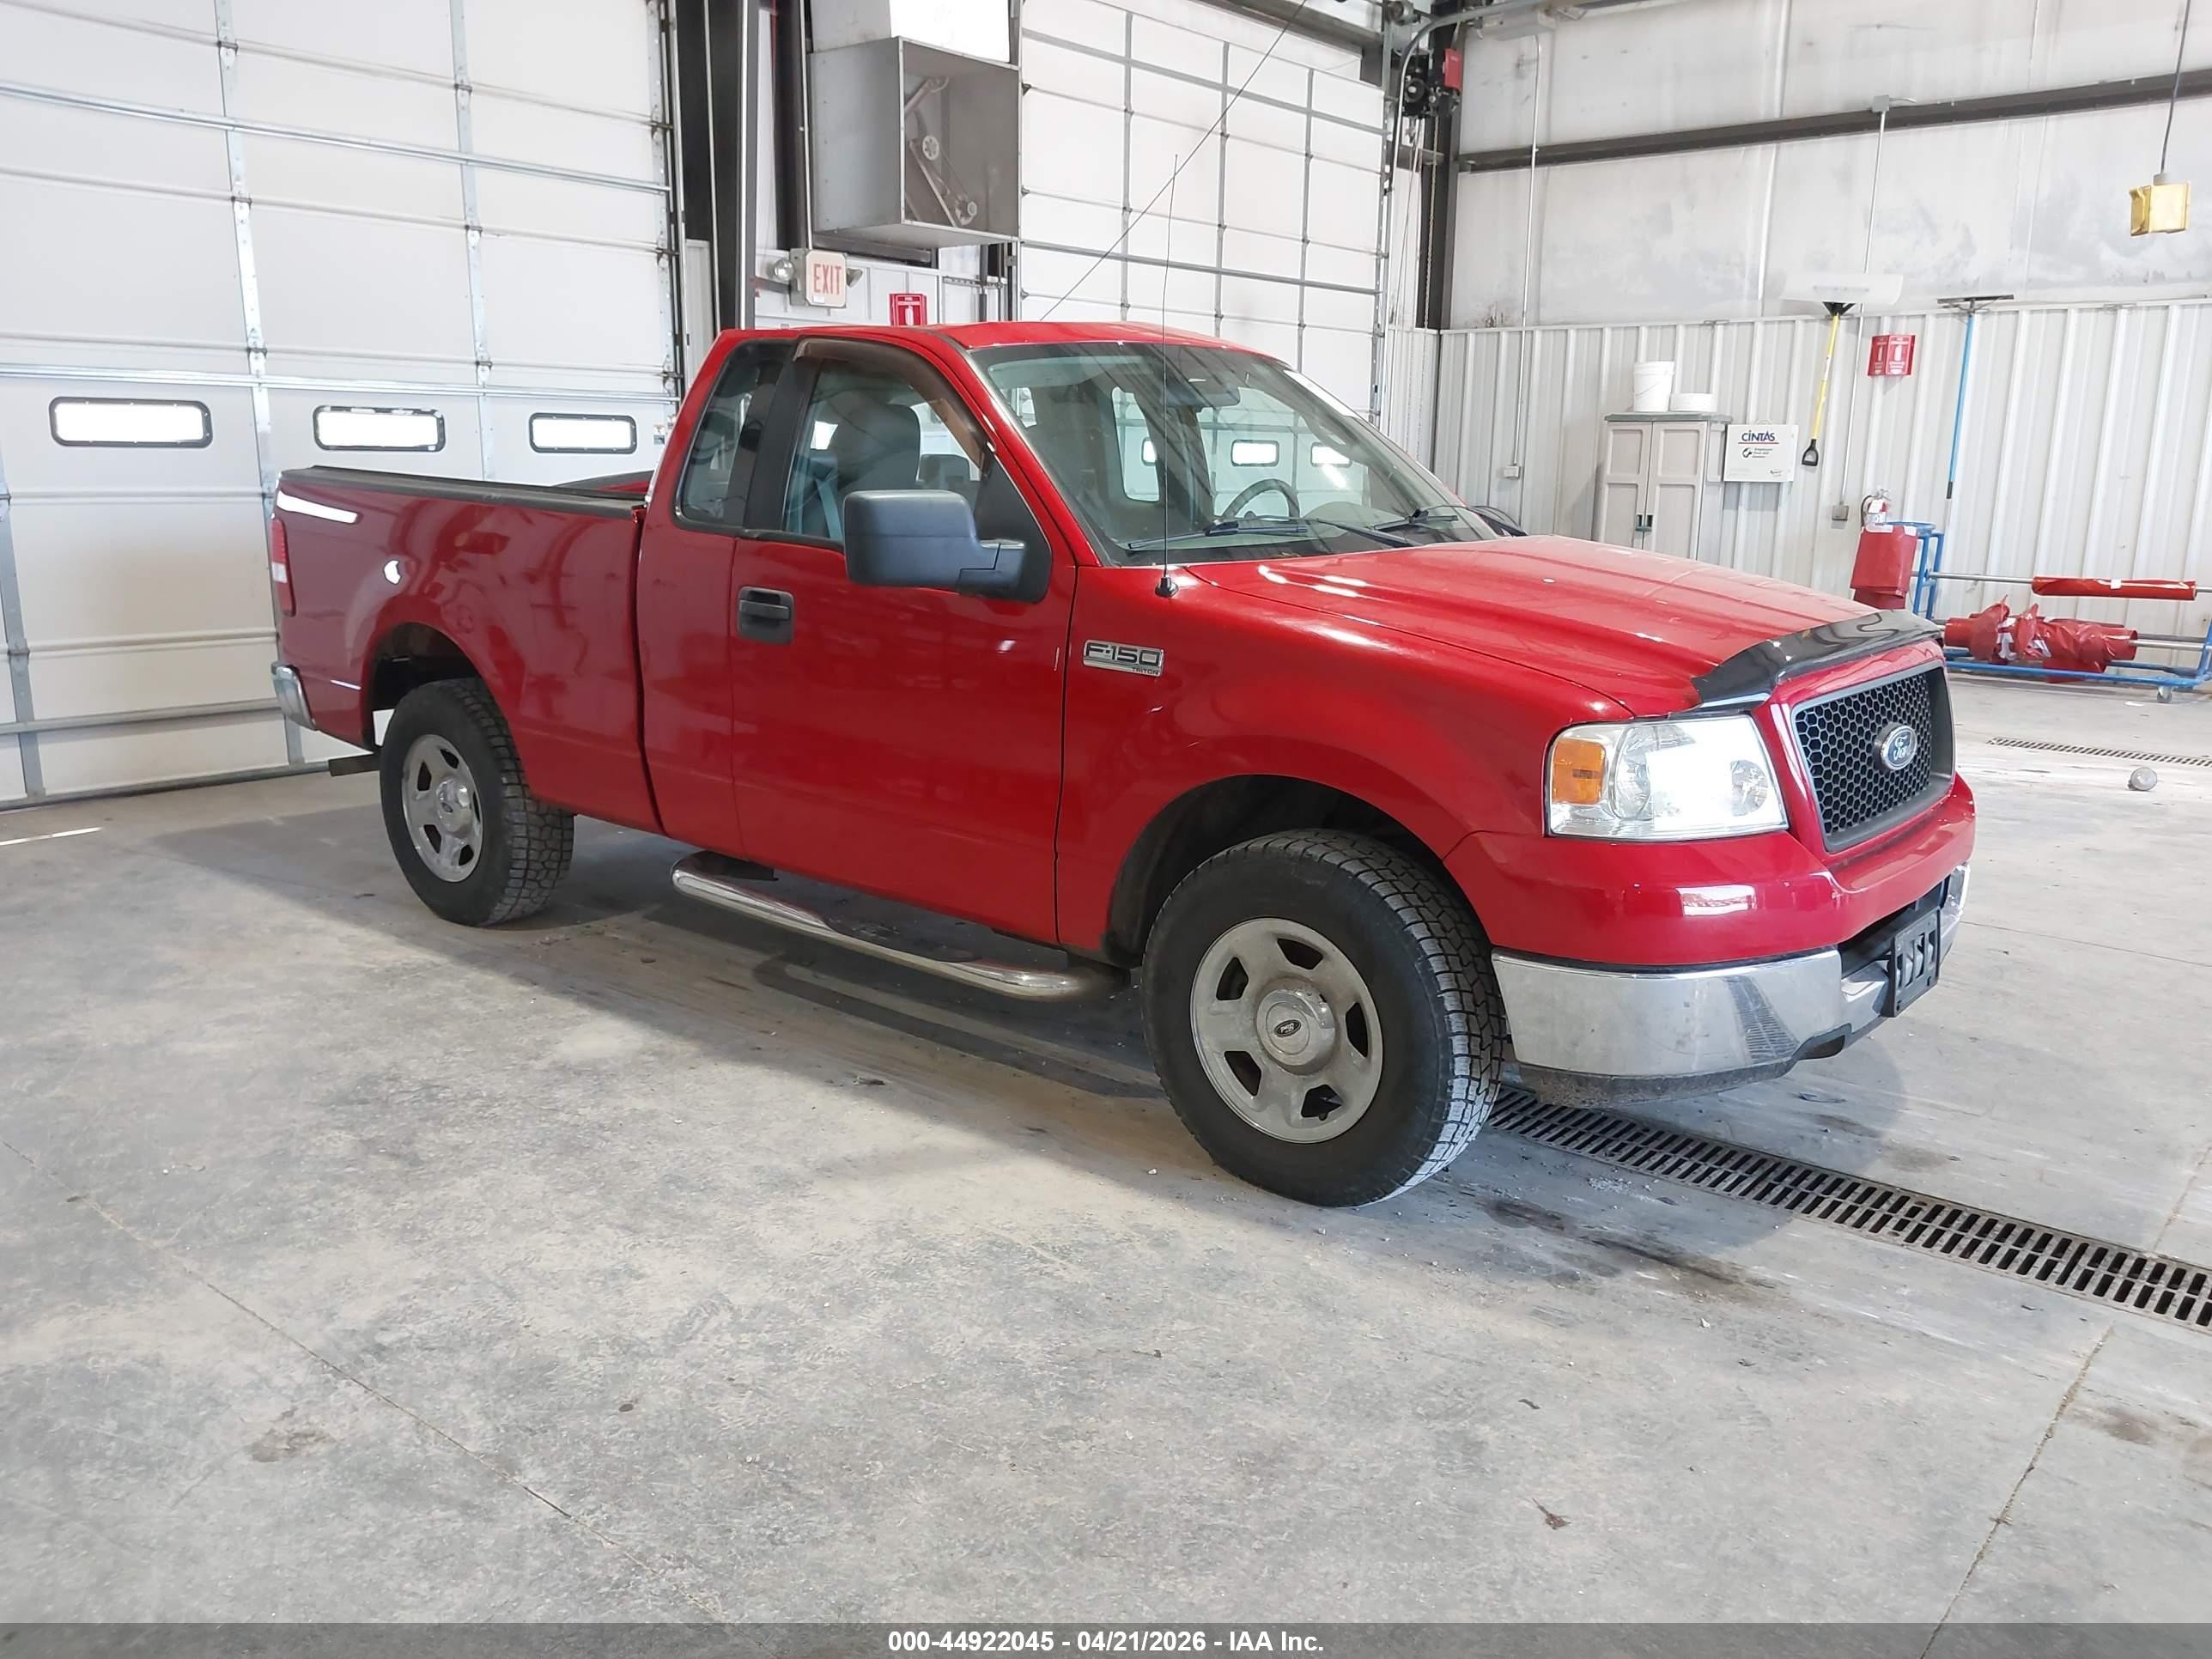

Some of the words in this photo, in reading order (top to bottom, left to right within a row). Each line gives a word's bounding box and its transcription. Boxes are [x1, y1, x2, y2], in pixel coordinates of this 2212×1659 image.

[812, 263, 842, 295] EXIT
[1741, 429, 1776, 442] CINTAS
[1085, 641, 1161, 667] F-150
[1131, 666, 1160, 676] TRITON
